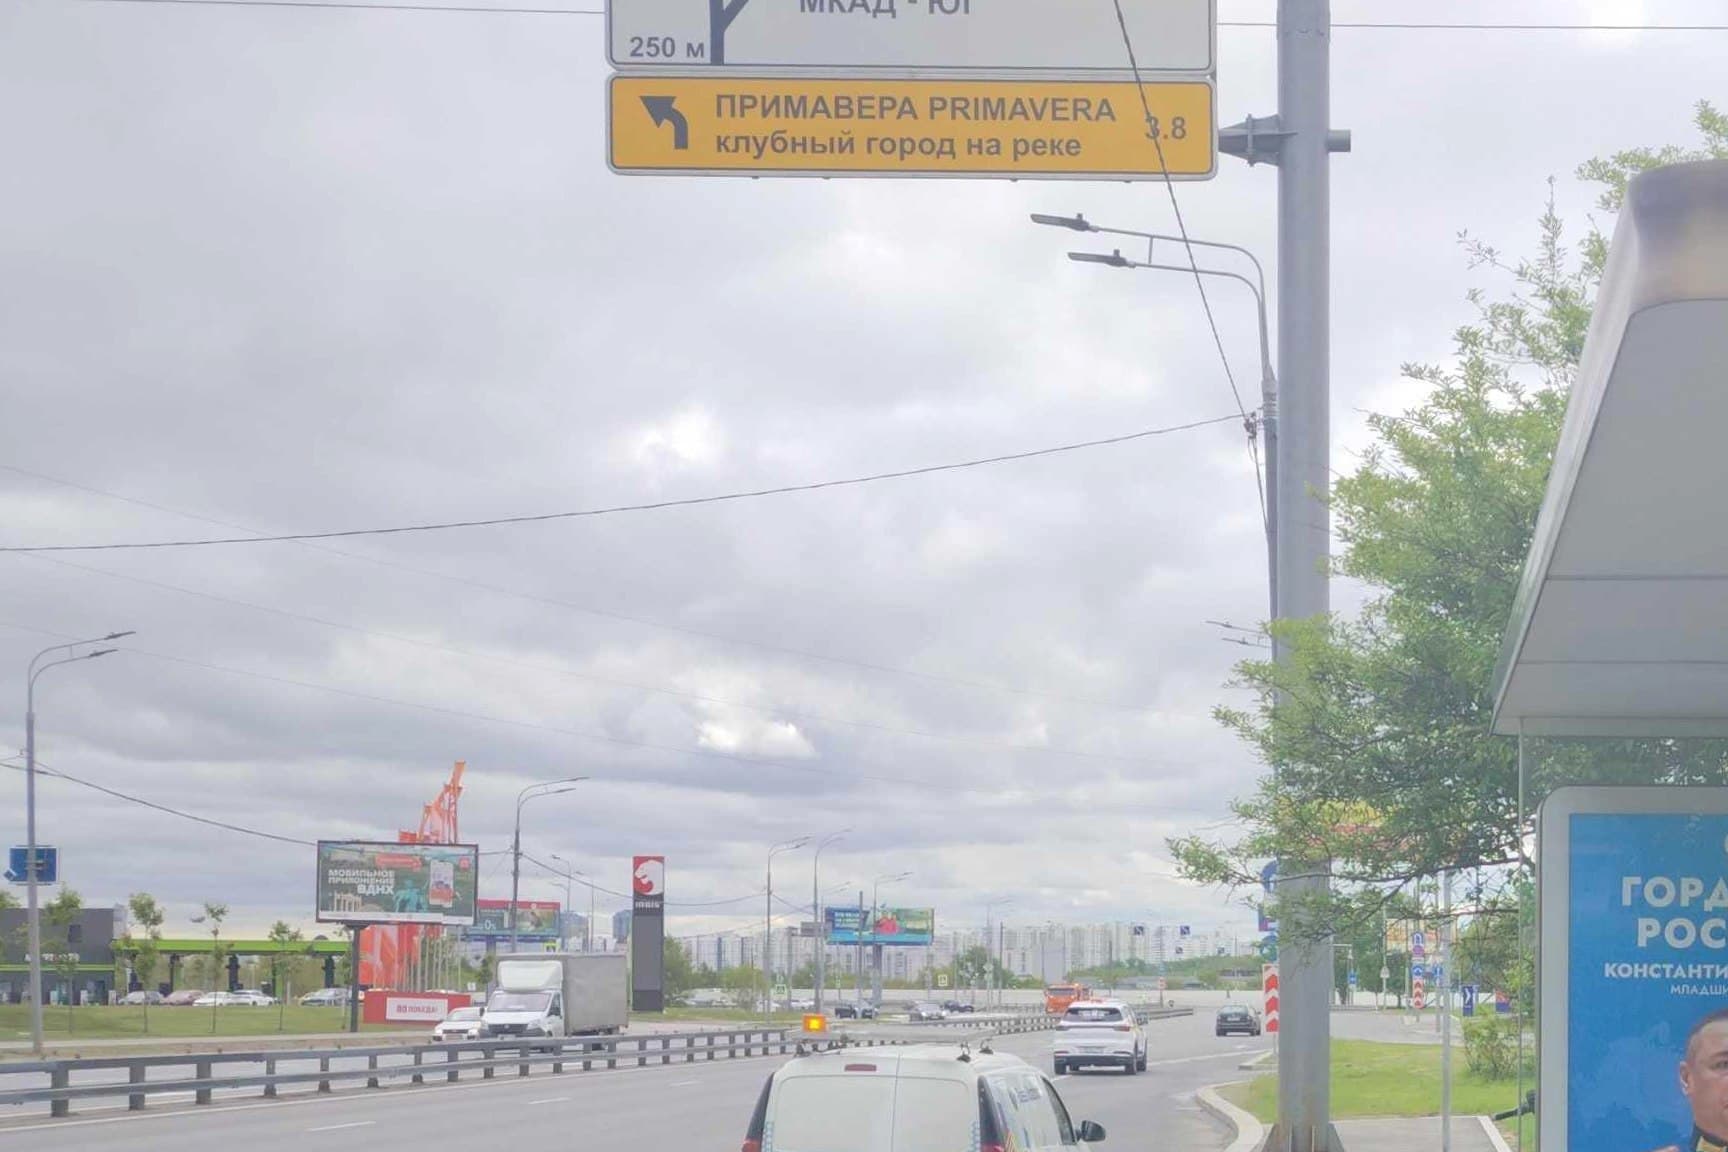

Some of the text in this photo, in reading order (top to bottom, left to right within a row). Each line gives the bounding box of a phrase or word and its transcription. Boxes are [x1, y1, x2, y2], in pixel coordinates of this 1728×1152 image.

[630, 36, 704, 58] 250 м
[715, 93, 1116, 123] ПРИМАВЕРА PRIMAVERA
[1145, 116, 1187, 141] 3.8
[716, 130, 1081, 163] клубный город на реке
